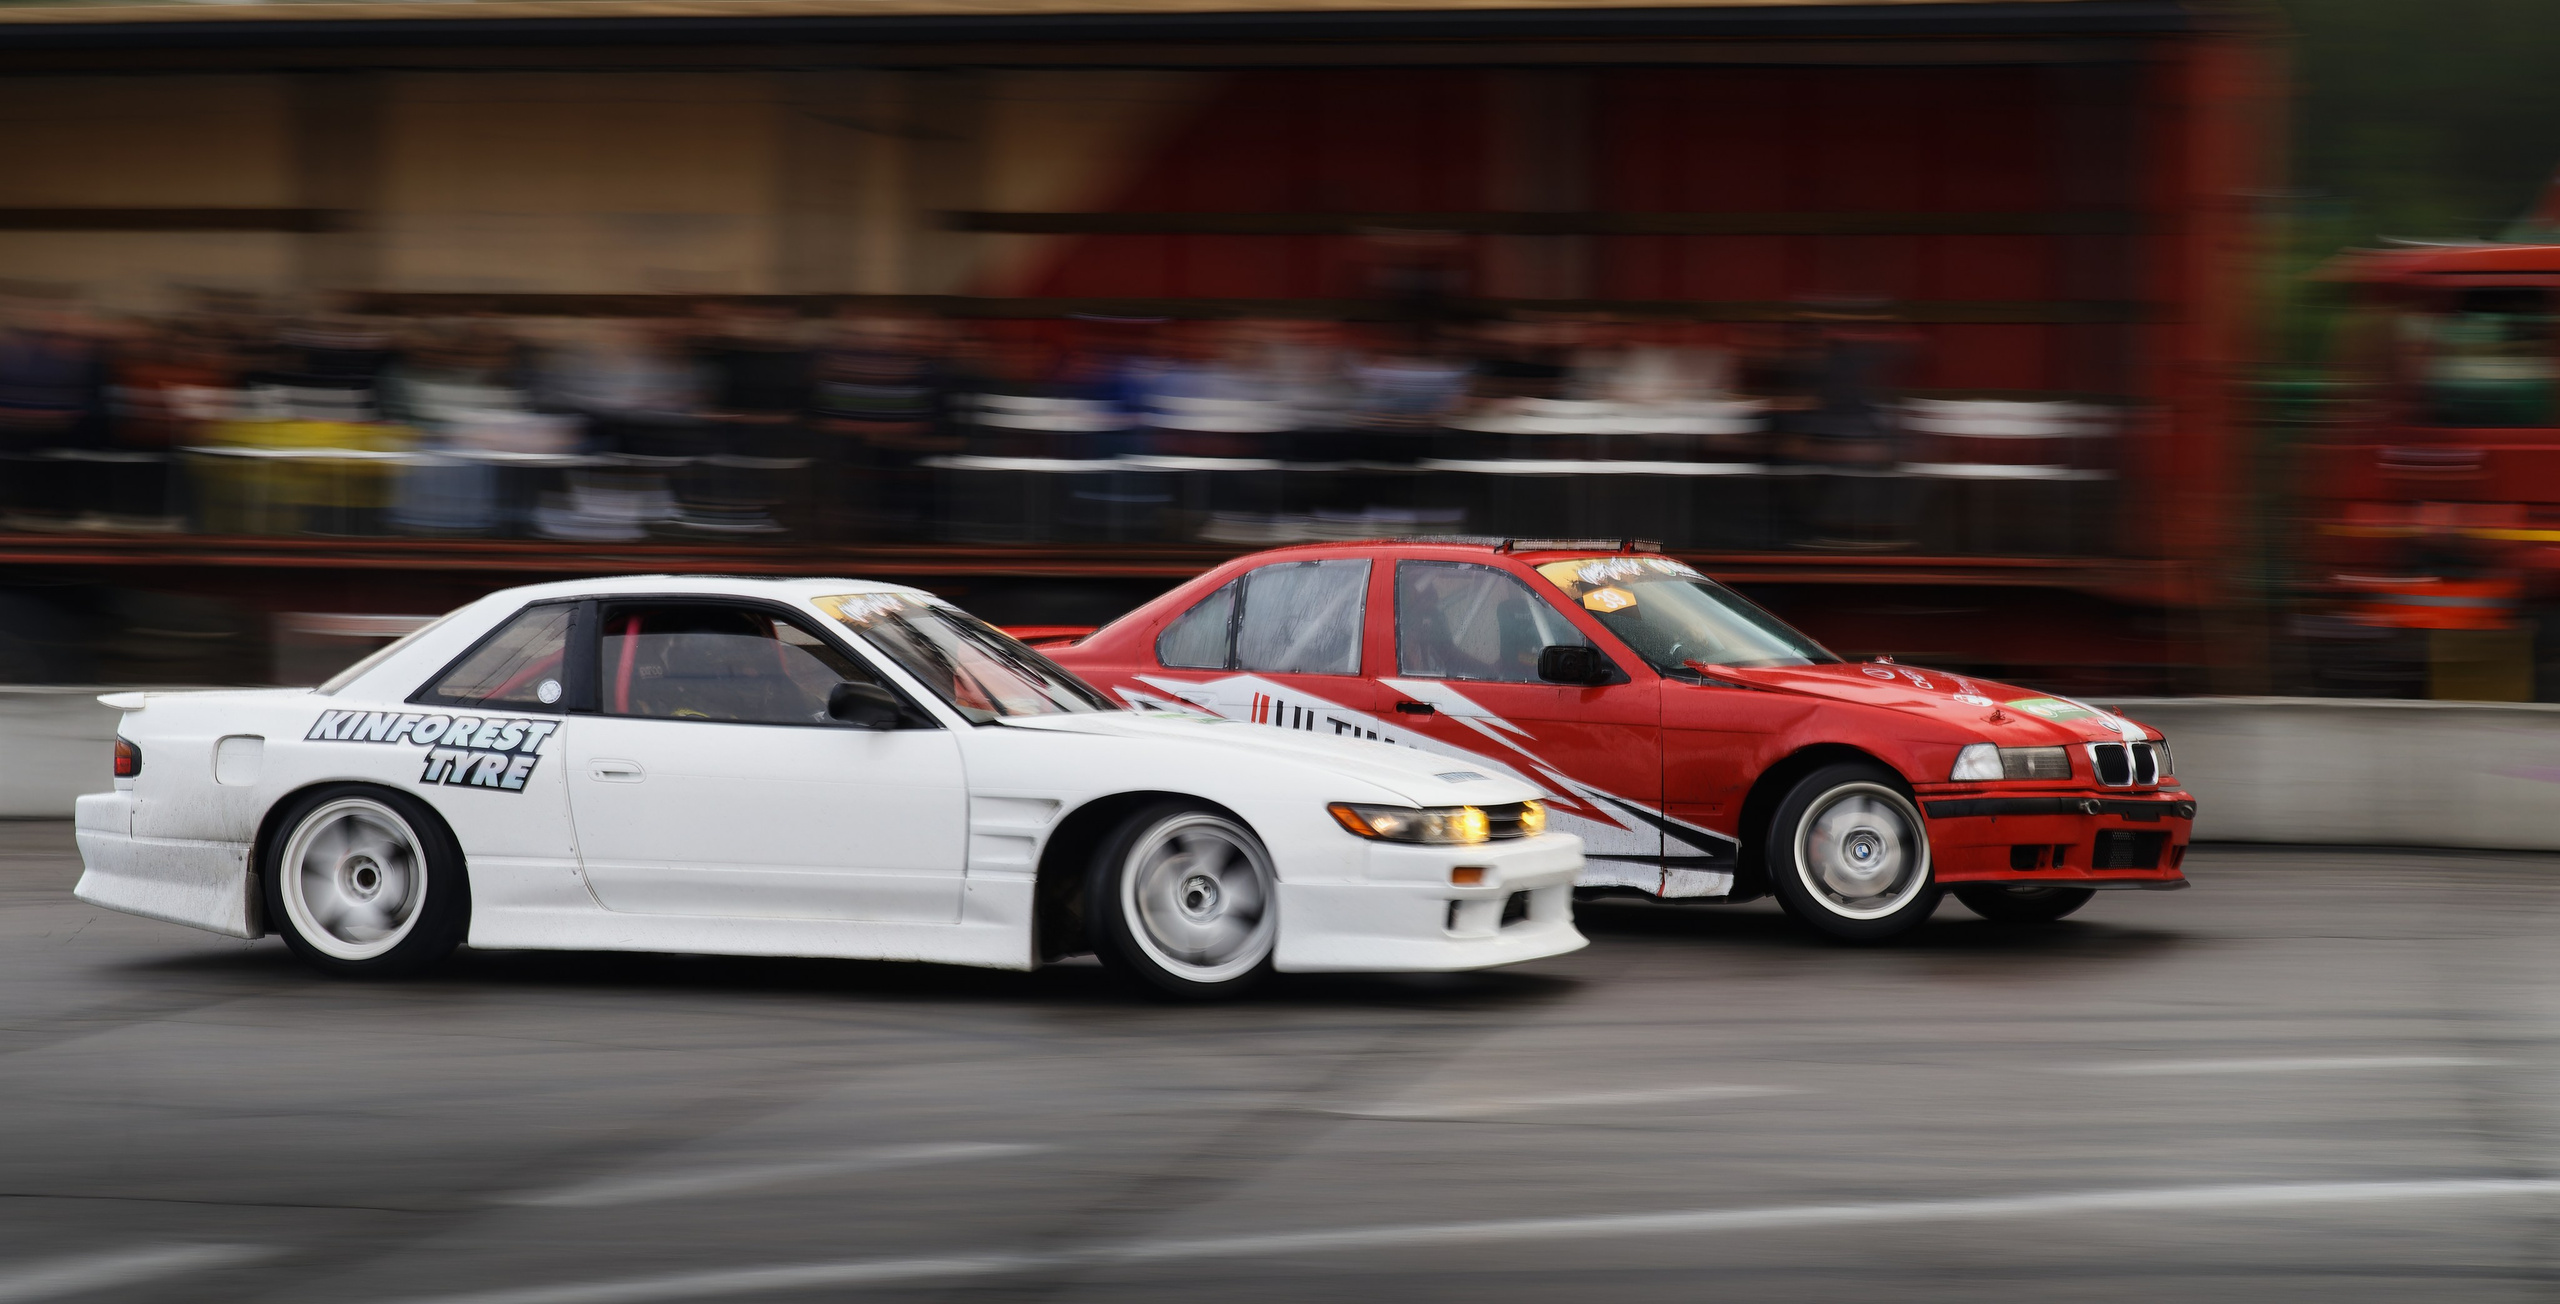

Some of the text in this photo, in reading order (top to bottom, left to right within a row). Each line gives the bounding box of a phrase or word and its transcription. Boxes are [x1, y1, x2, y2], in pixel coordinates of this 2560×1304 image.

[1593, 588, 1627, 609] 39
[306, 709, 560, 752] KINFOREST
[423, 748, 537, 791] TYRE
